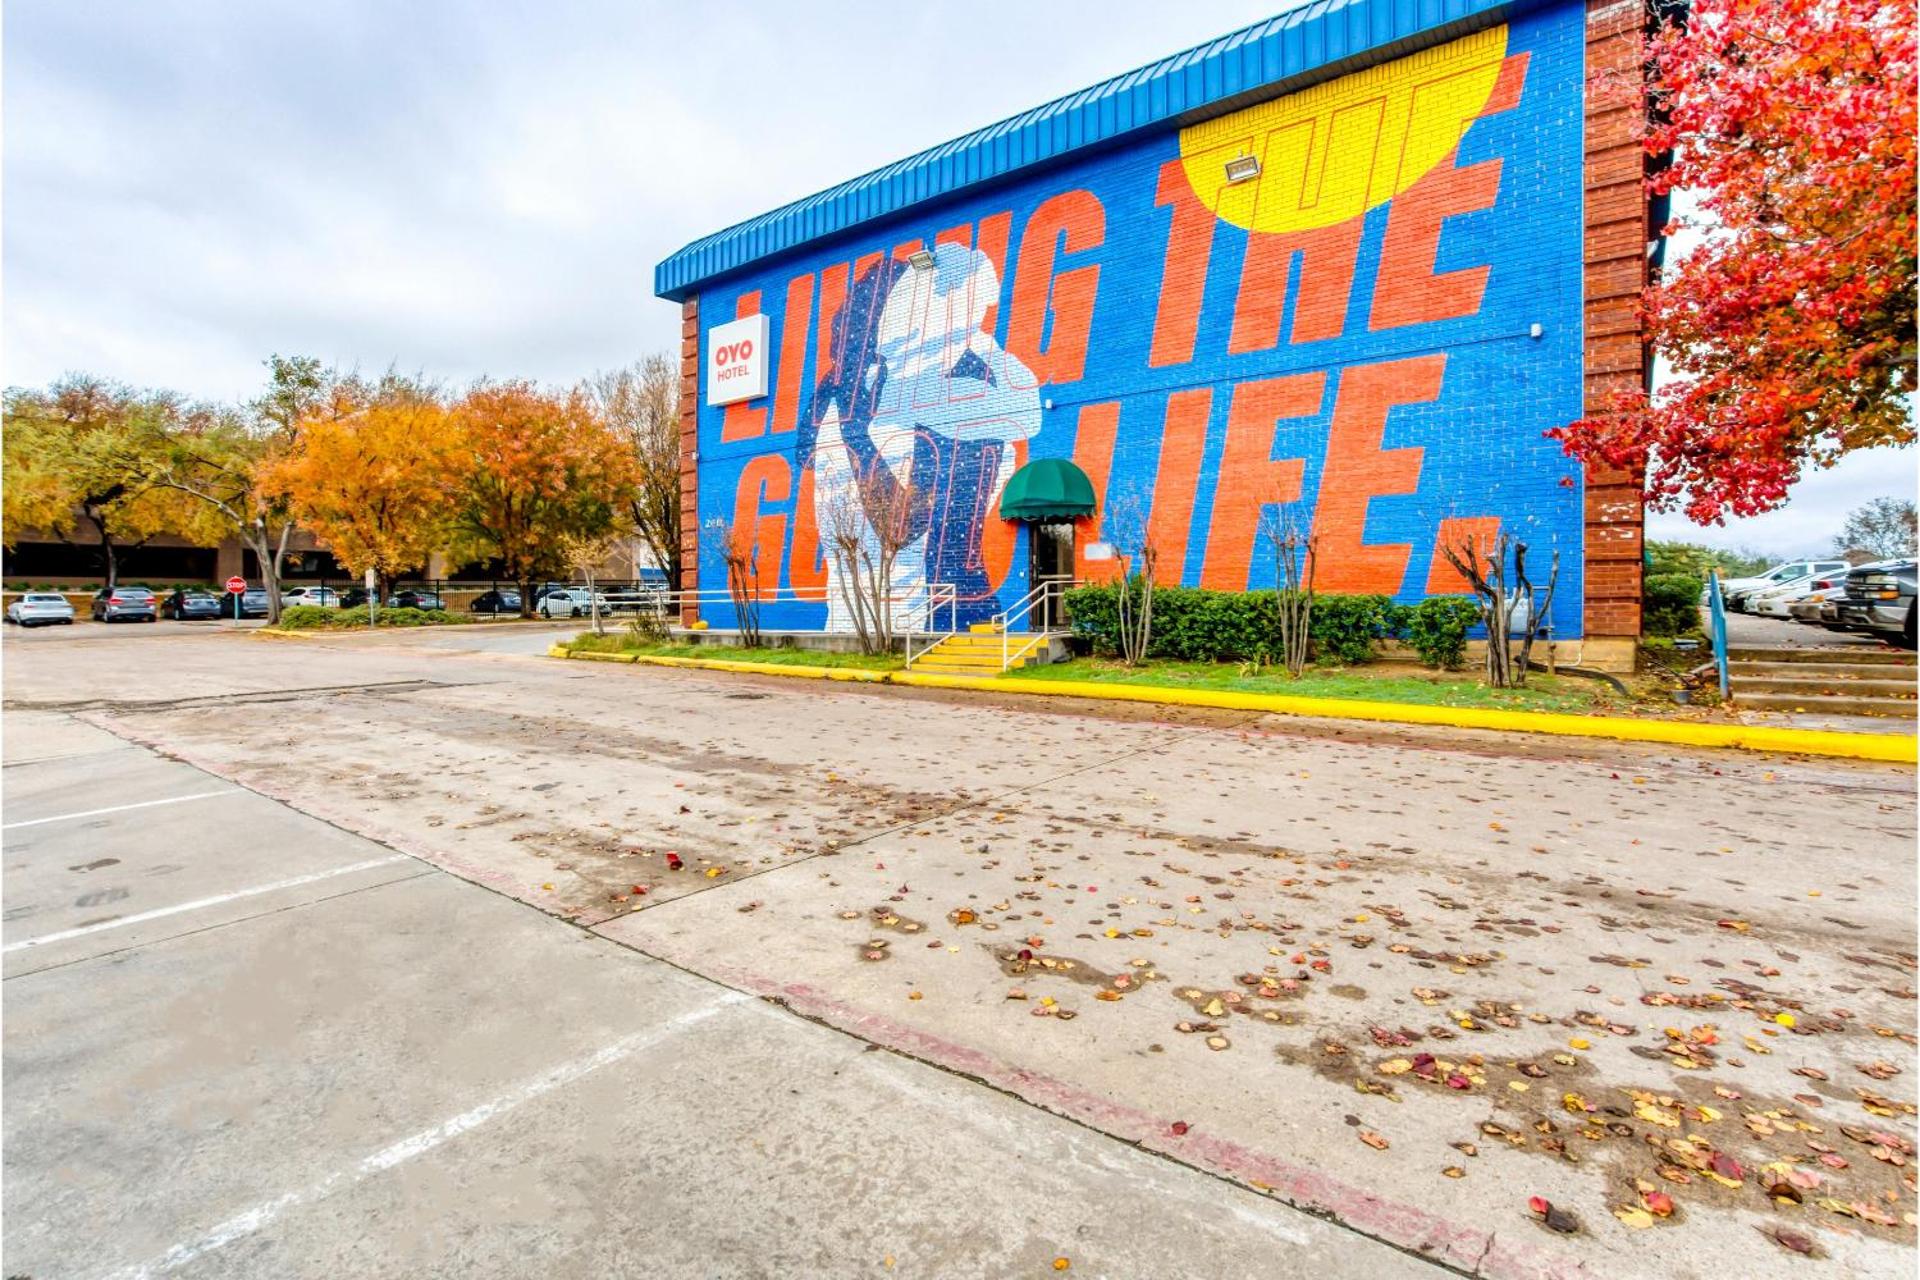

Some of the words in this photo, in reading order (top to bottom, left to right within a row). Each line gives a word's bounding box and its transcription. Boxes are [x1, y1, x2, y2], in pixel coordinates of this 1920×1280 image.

[1148, 51, 1532, 369] THE
[716, 339, 753, 366] OYO
[717, 364, 750, 383] HOTEL
[728, 418, 1029, 604] GOOD
